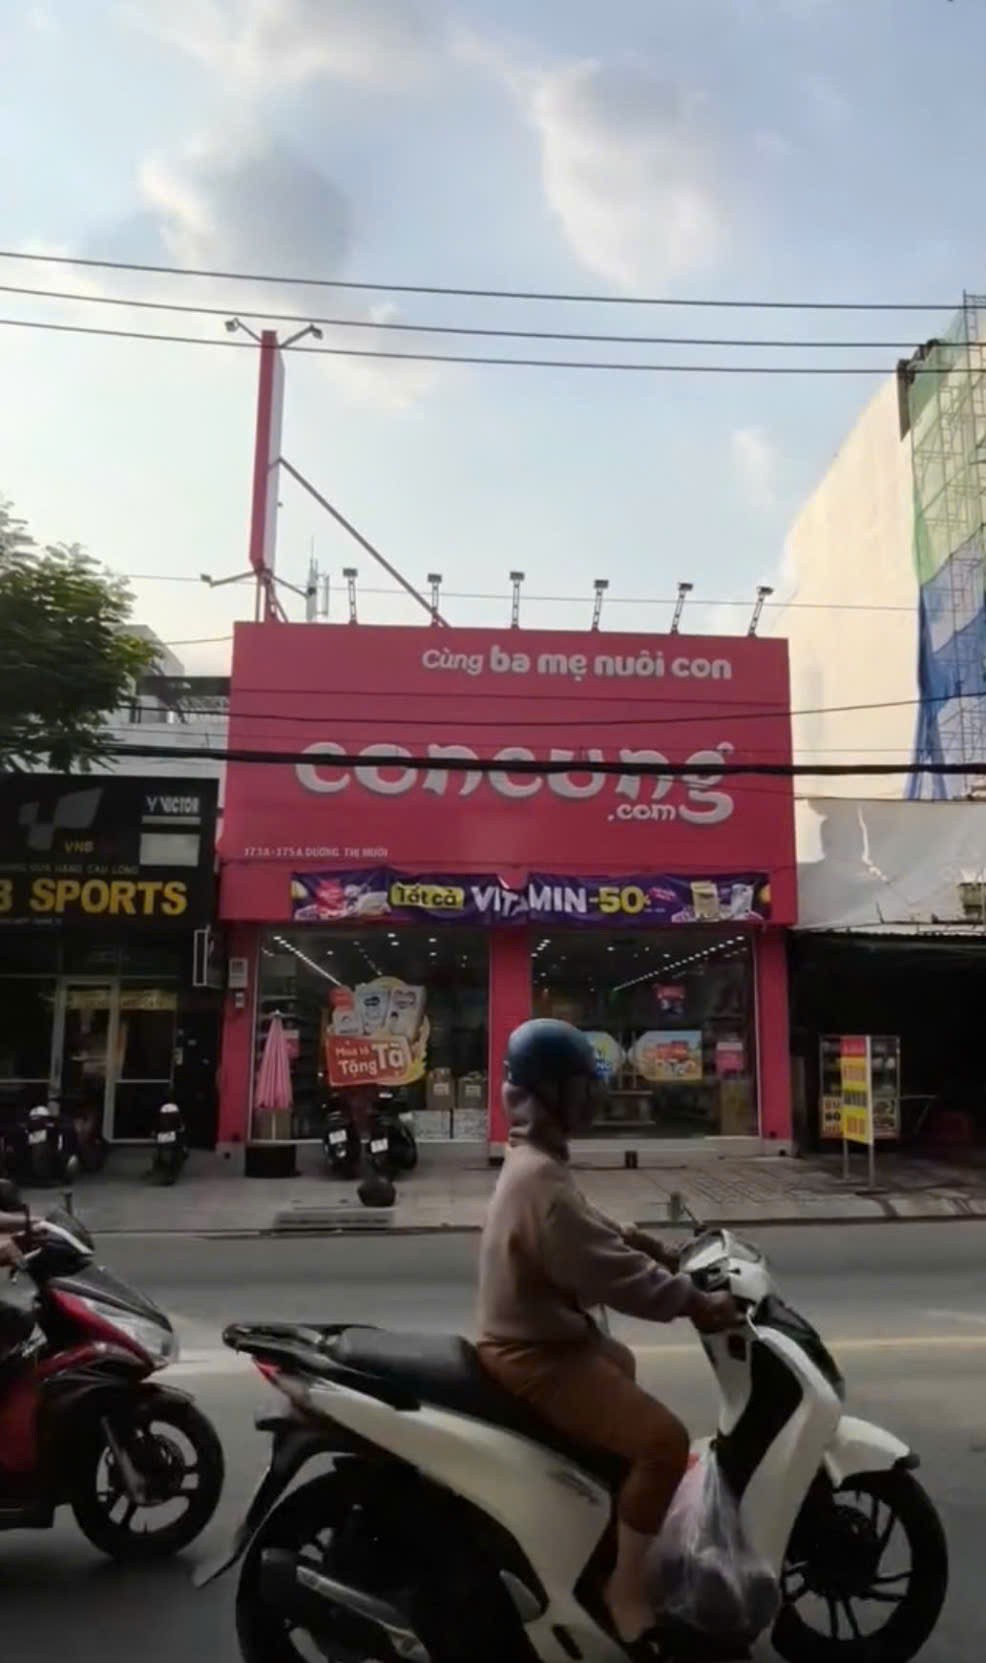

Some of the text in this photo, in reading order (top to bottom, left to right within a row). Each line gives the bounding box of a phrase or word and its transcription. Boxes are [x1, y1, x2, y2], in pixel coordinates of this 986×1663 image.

[422, 644, 733, 681] Cùng ba mẹ nuôi con
[607, 802, 677, 822] .com
[29, 878, 188, 916] SPORTS
